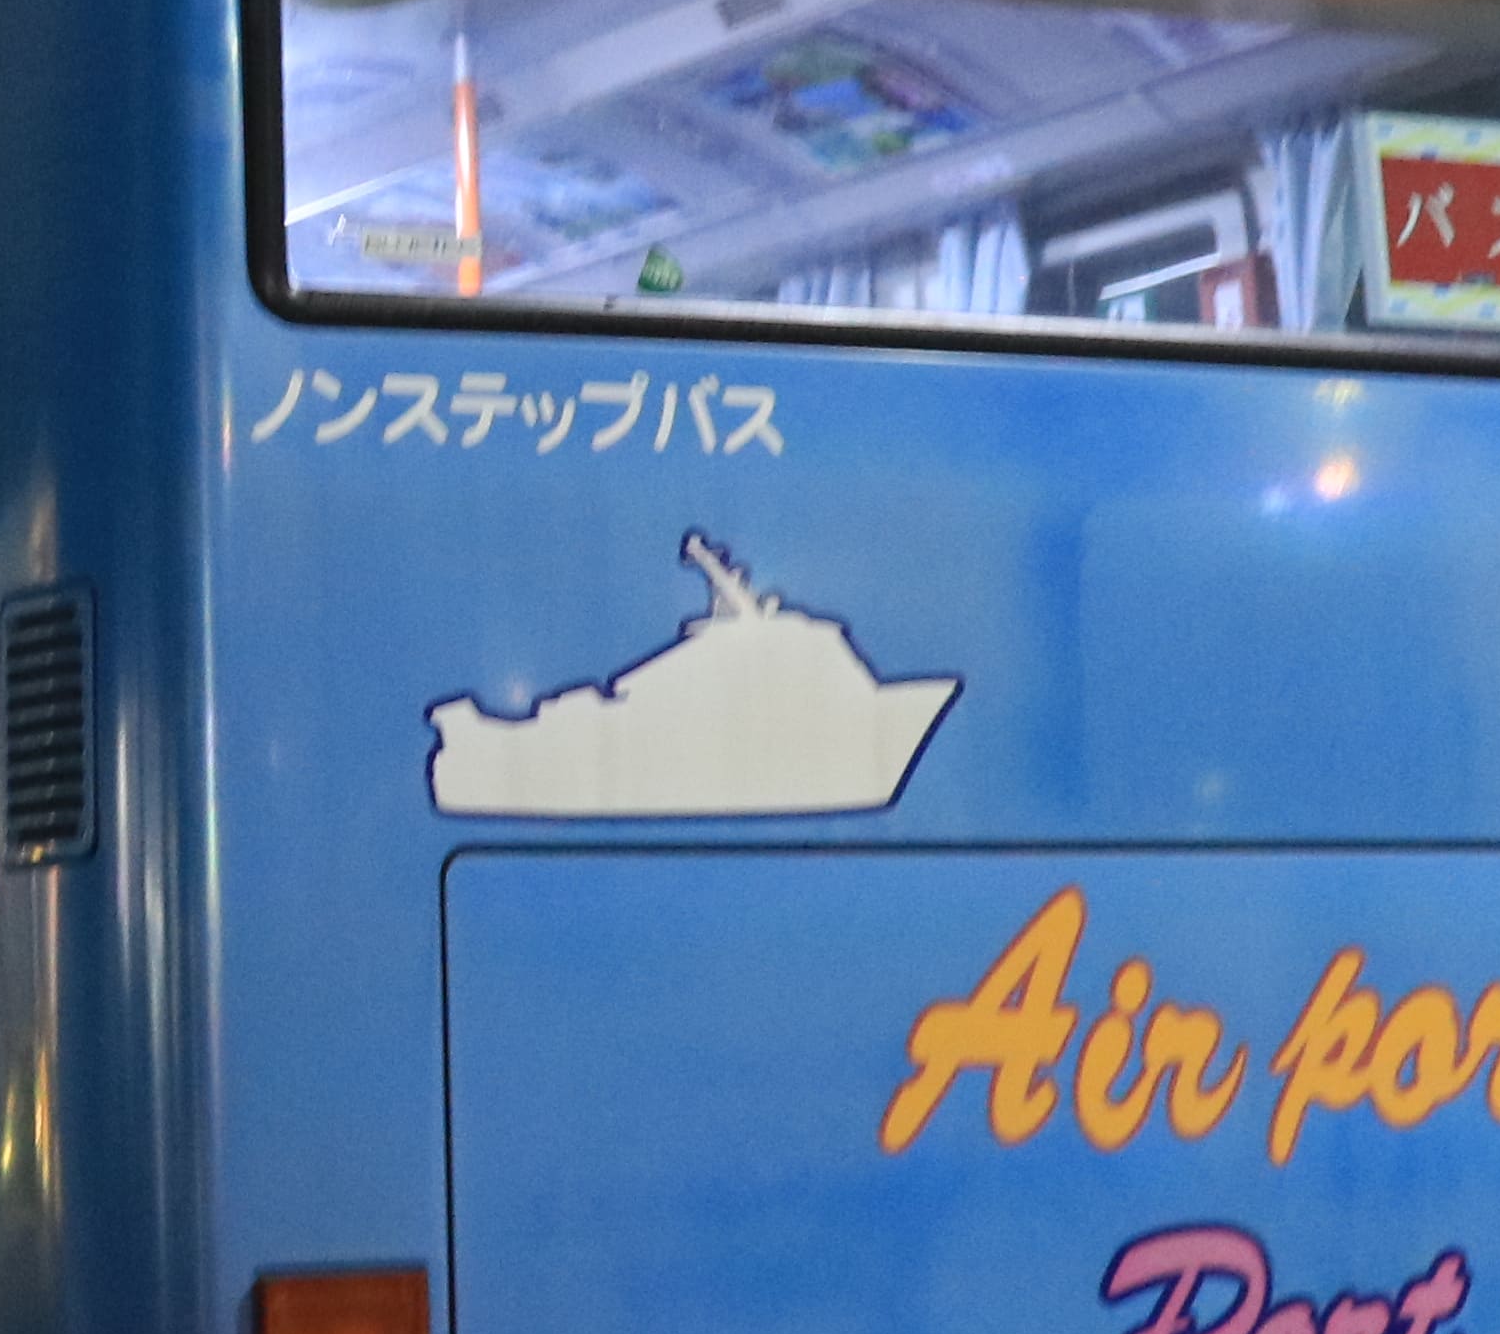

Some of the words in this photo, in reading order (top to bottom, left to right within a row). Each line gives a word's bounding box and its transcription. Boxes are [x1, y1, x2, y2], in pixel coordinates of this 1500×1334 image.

[251, 368, 785, 456] ノンステップバス
[878, 883, 1250, 1154] Air
